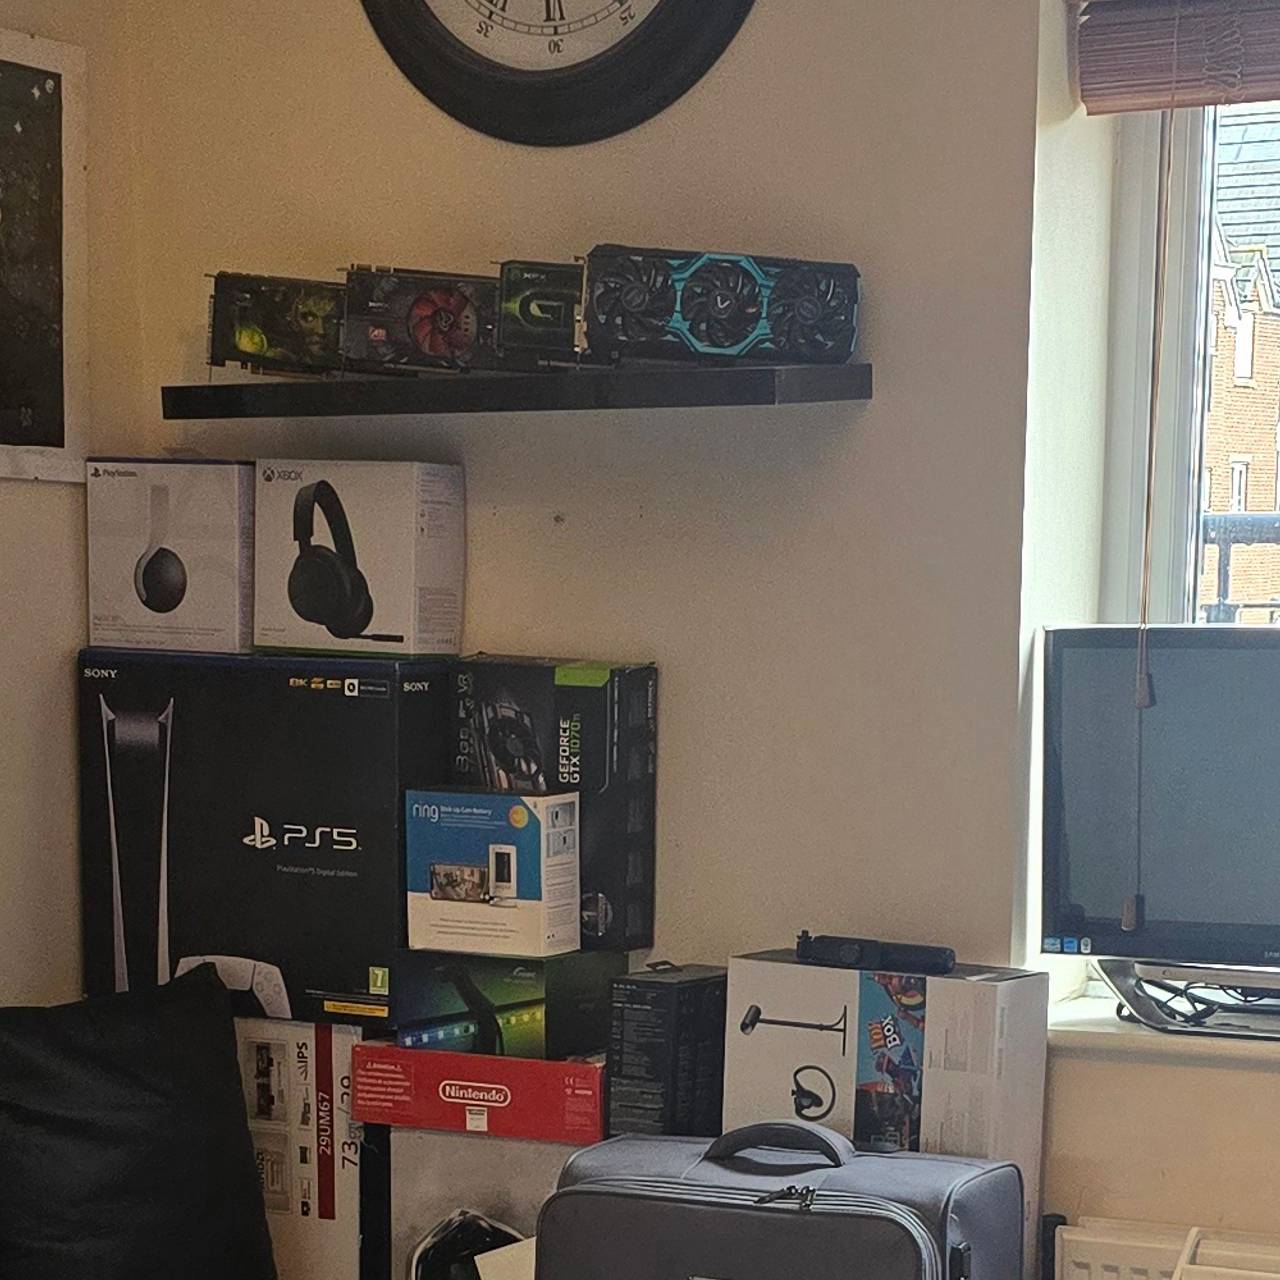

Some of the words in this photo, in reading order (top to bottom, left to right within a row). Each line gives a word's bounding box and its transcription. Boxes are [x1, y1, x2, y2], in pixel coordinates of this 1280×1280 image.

[620, 4, 636, 26] 25
[476, 21, 494, 39] 35
[548, 38, 564, 55] 30
[276, 470, 303, 482] XBOX
[84, 668, 118, 679] SONY
[403, 681, 430, 692] SONY
[559, 719, 570, 784] GEFORCE
[569, 756, 580, 784] GTX
[413, 804, 439, 822] ring
[283, 824, 358, 850] PS5
[880, 1015, 902, 1049] BOX
[297, 1041, 309, 1065] IPS
[444, 1085, 506, 1103] Nintendo
[319, 1092, 331, 1156] 29UM67
